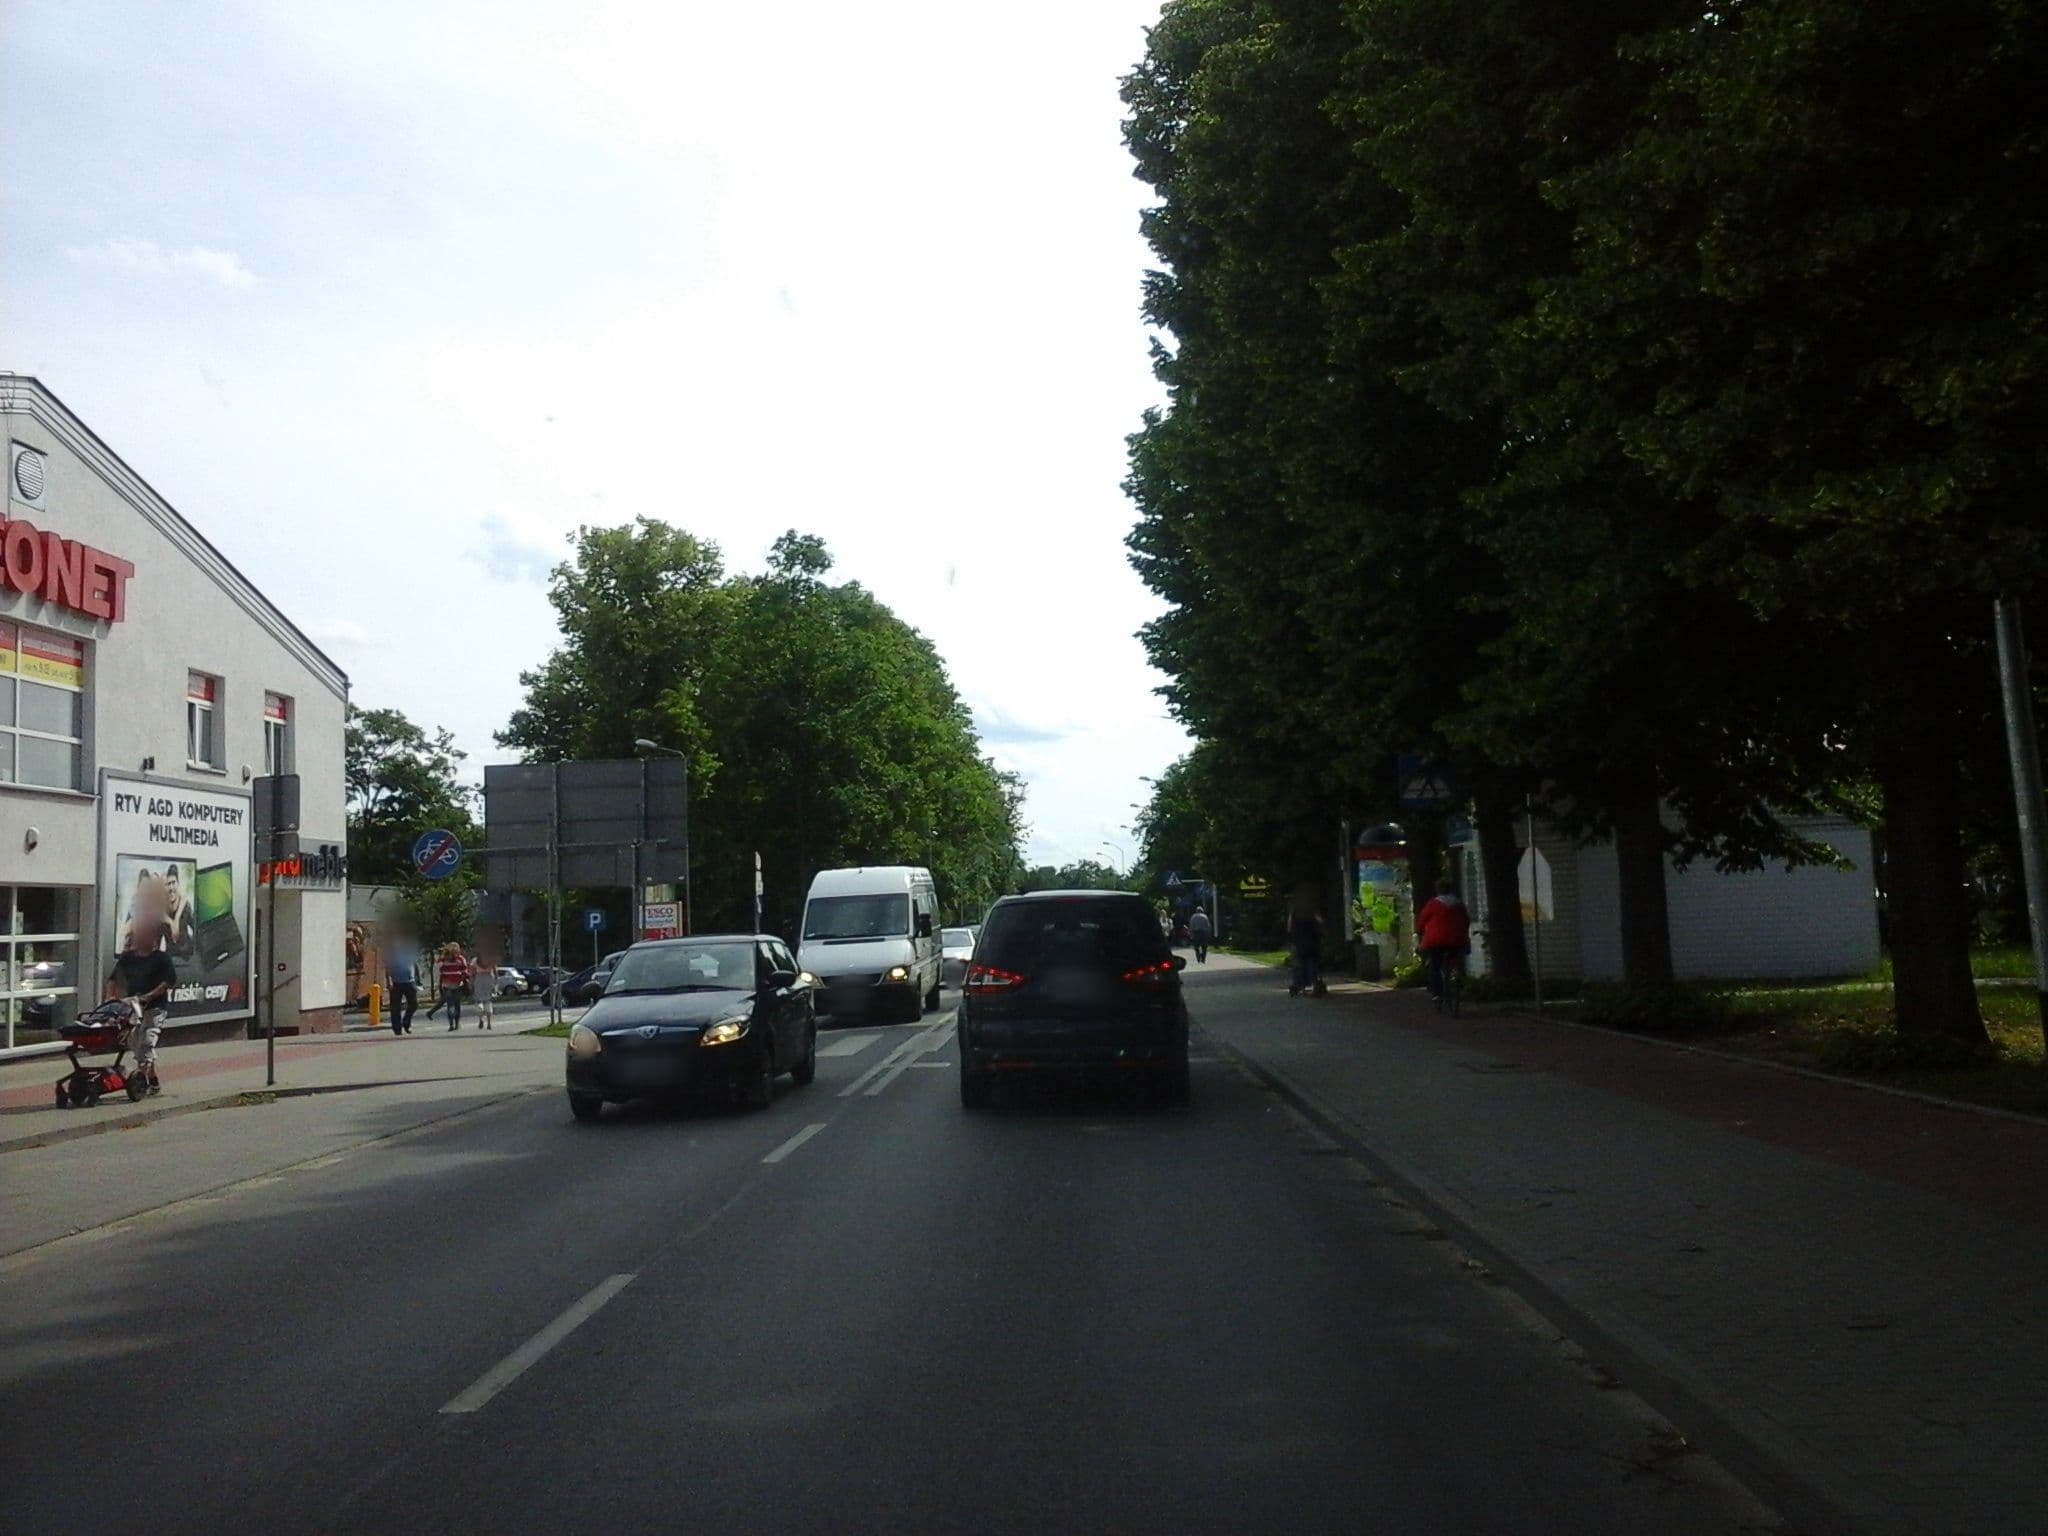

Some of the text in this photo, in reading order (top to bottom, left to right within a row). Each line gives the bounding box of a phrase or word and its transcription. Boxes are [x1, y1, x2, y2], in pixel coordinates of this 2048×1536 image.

[0, 511, 134, 623] ONET
[115, 793, 243, 825] RTV AGD KOMPUTERY
[149, 823, 219, 847] MULTIMEDIA
[590, 912, 601, 928] P
